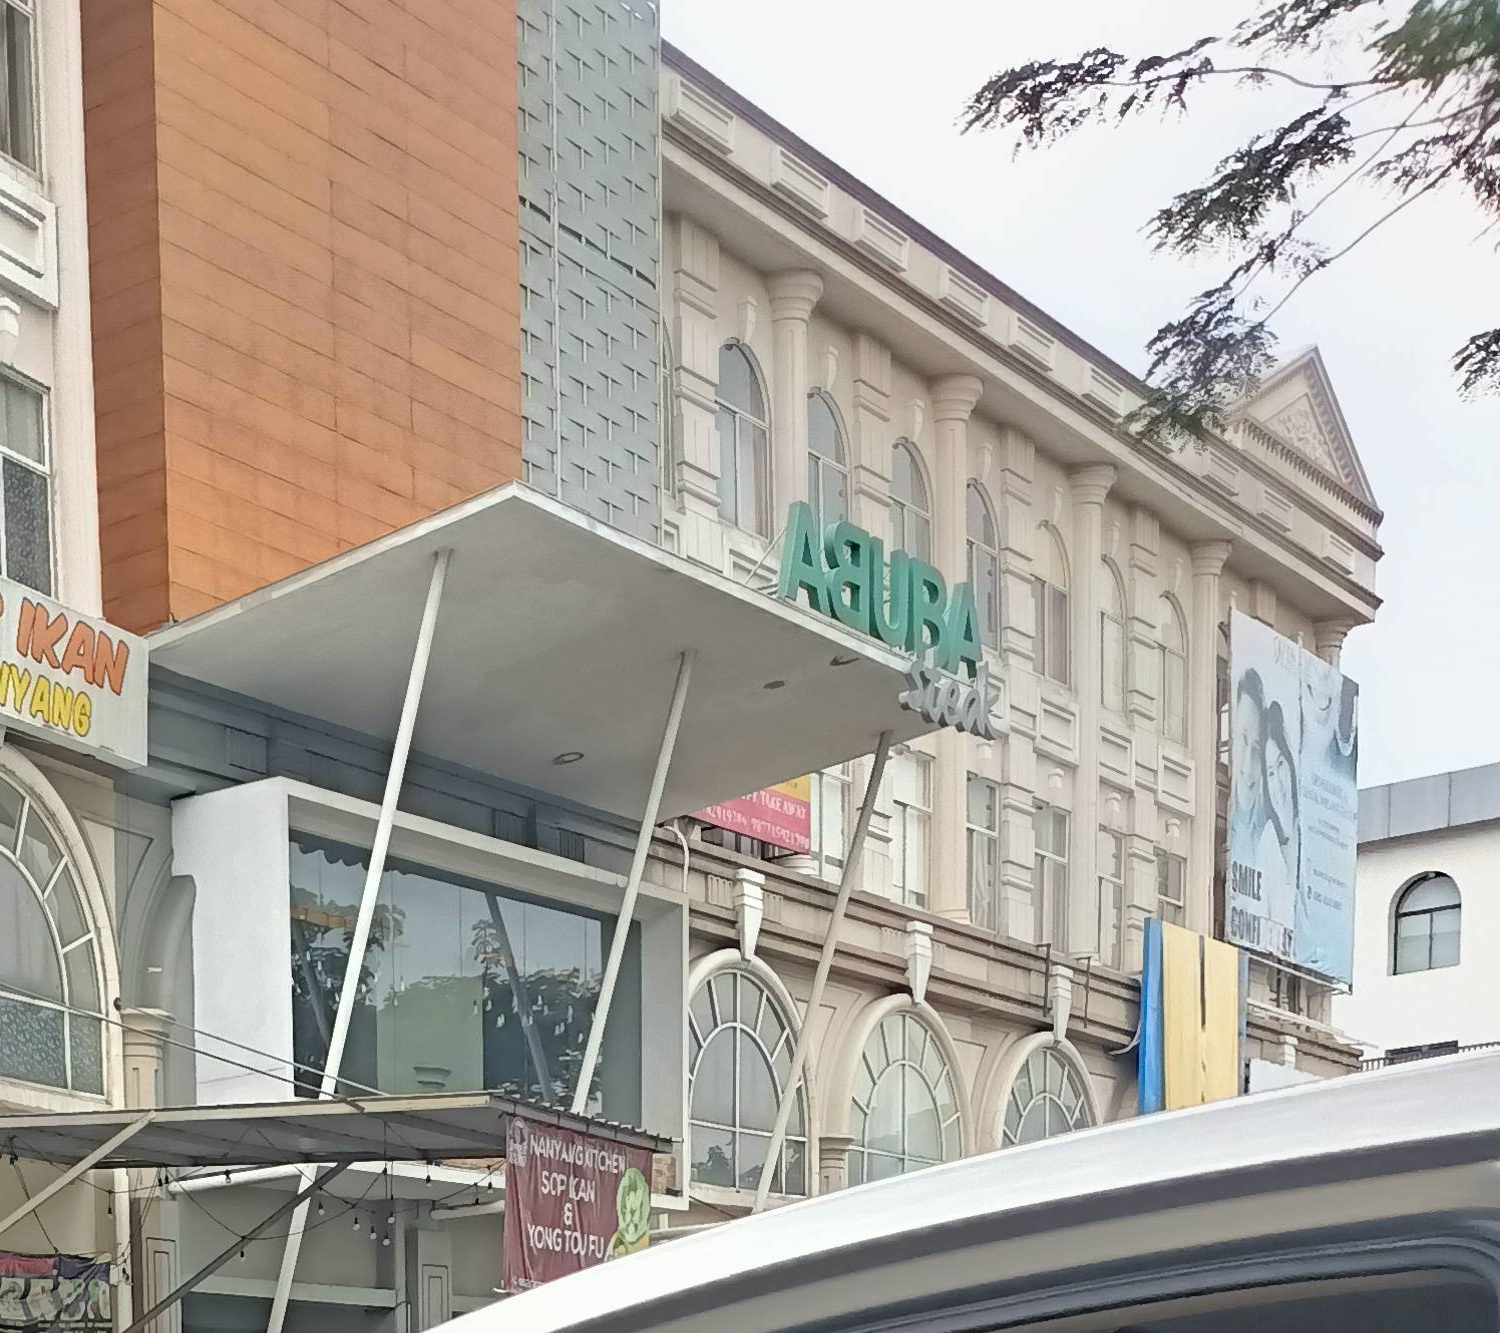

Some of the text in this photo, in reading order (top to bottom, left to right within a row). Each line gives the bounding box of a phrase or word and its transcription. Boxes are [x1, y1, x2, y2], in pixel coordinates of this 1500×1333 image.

[16, 597, 130, 696] IKAN
[1231, 860, 1262, 902] SMILE
[563, 1202, 574, 1227] &
